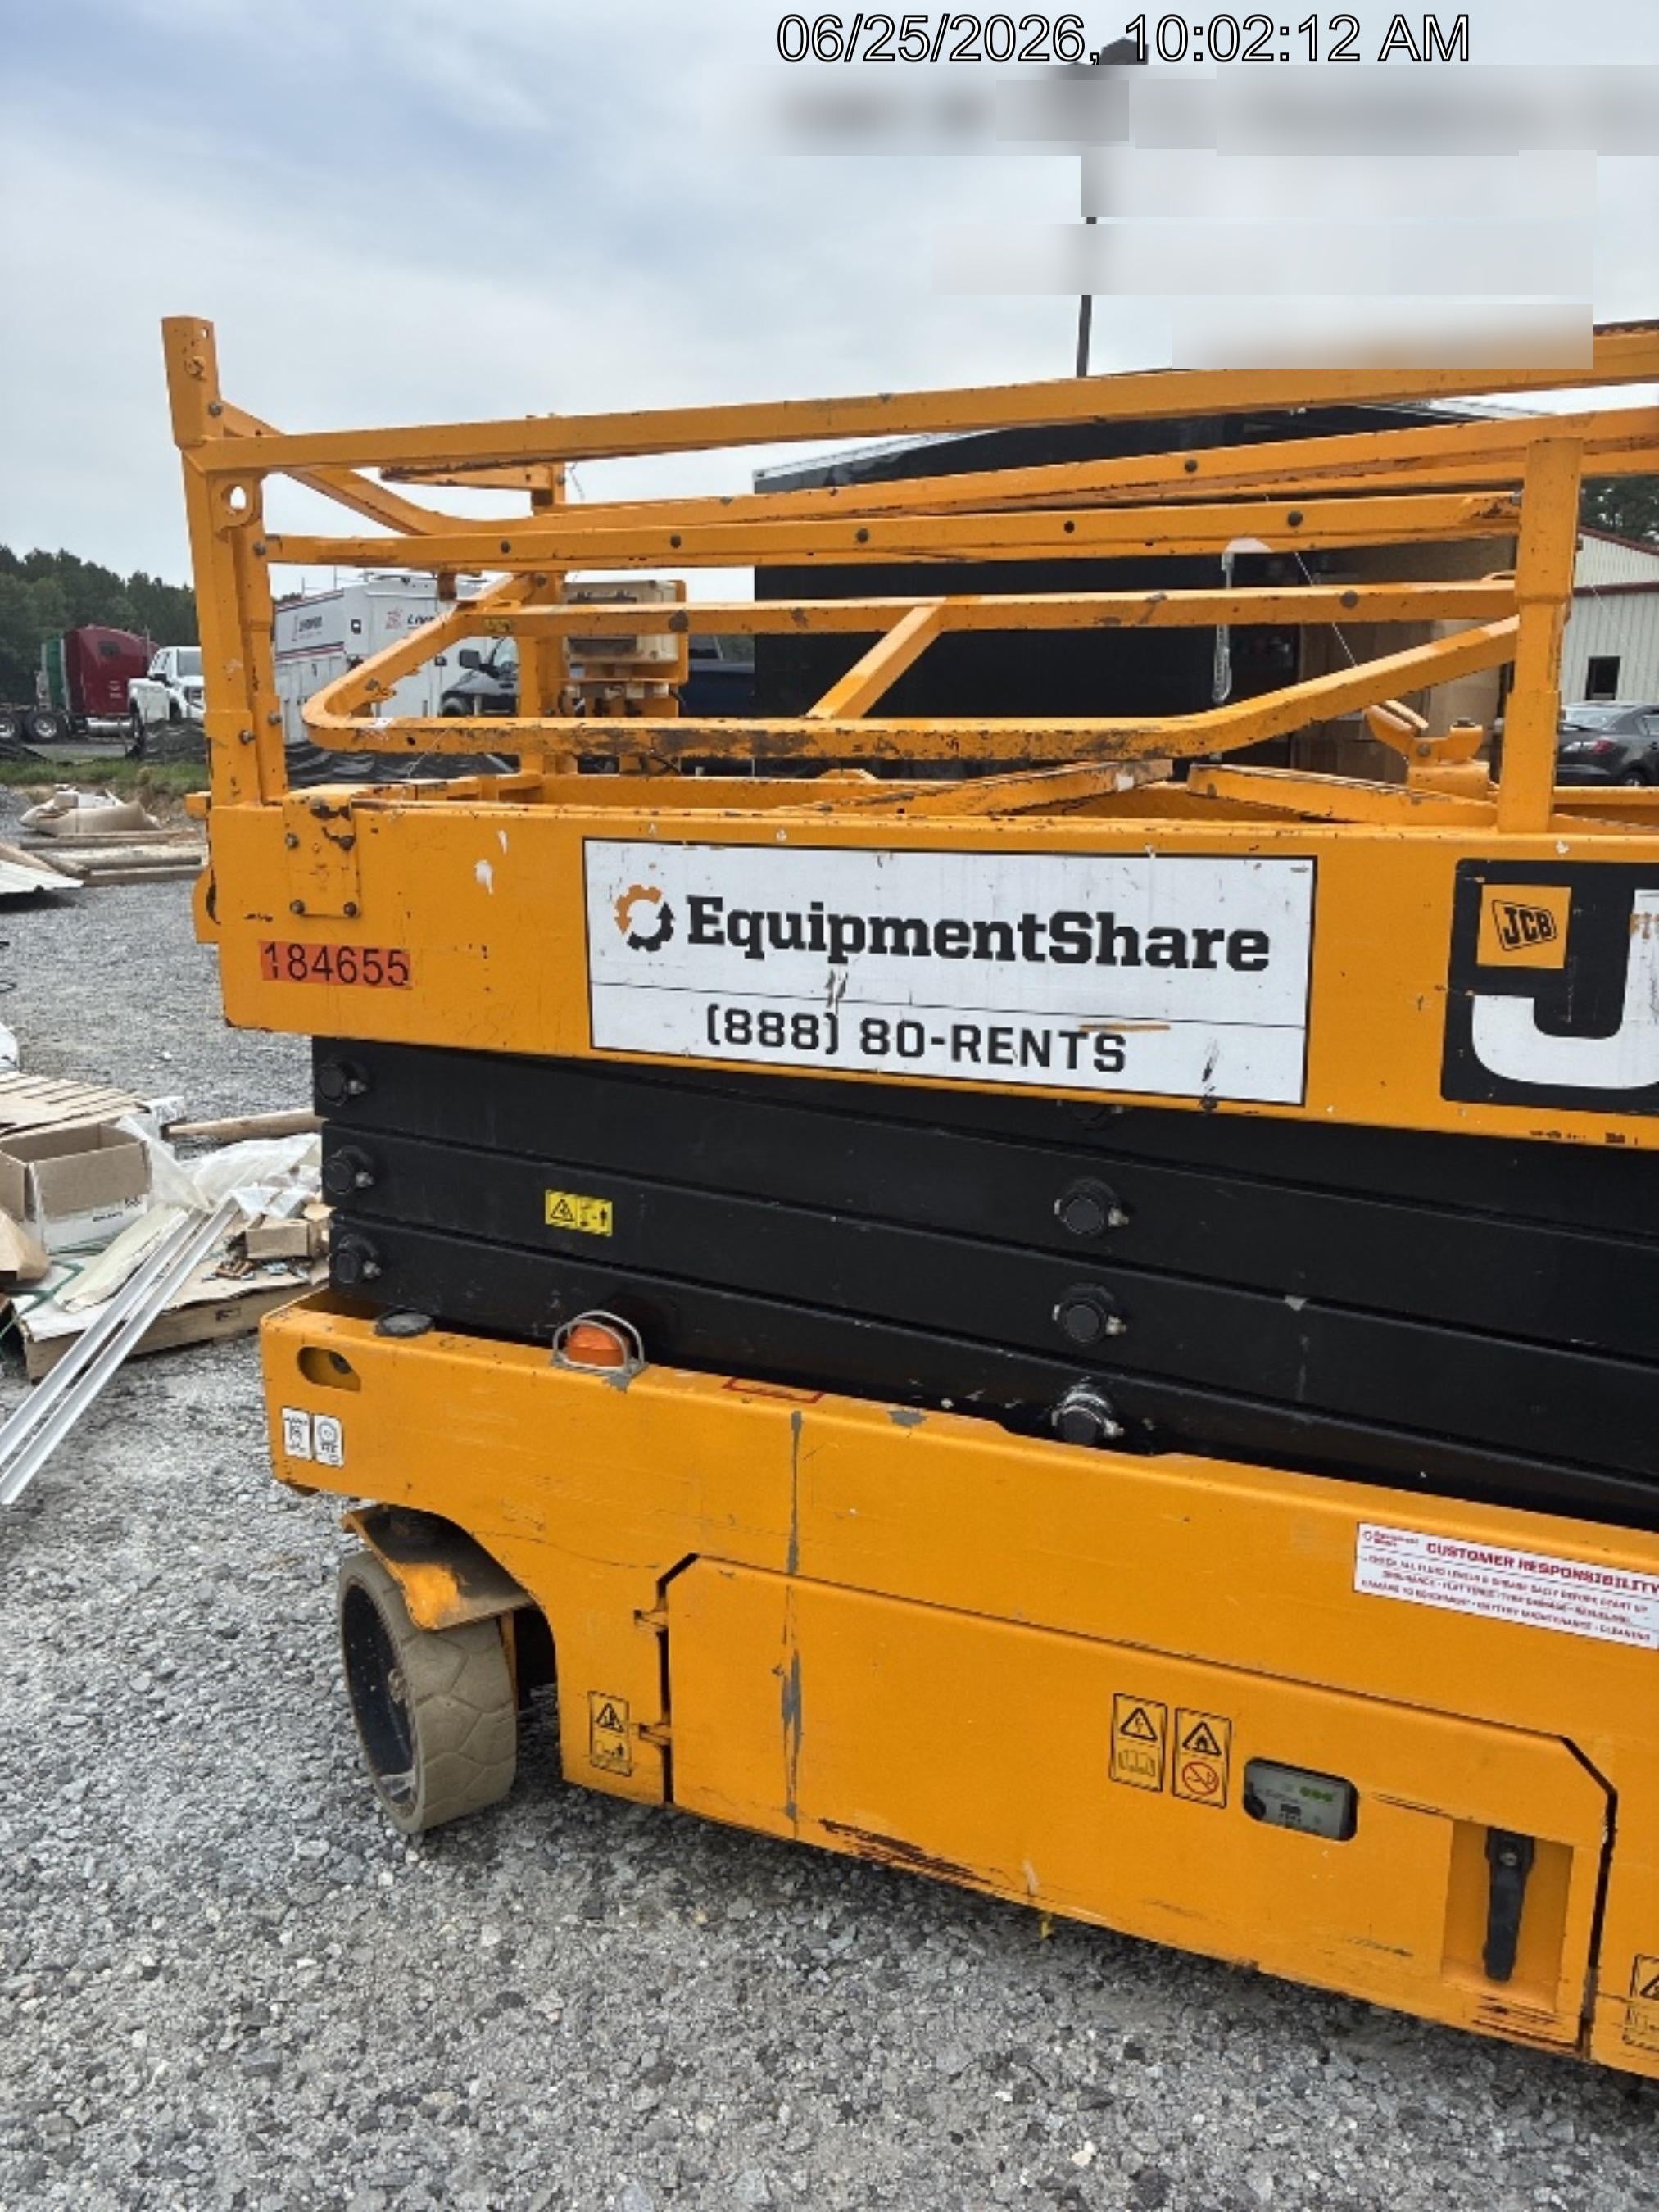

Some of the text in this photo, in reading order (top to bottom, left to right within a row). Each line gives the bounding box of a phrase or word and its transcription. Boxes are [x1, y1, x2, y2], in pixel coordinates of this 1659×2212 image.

[686, 894, 1271, 972] EquipmentShare
[1500, 906, 1554, 947] JCB
[264, 941, 409, 986] 184655
[707, 1002, 1126, 1074] (888) 80-RENTS
[1426, 1541, 1514, 1568] CUSTOMER
